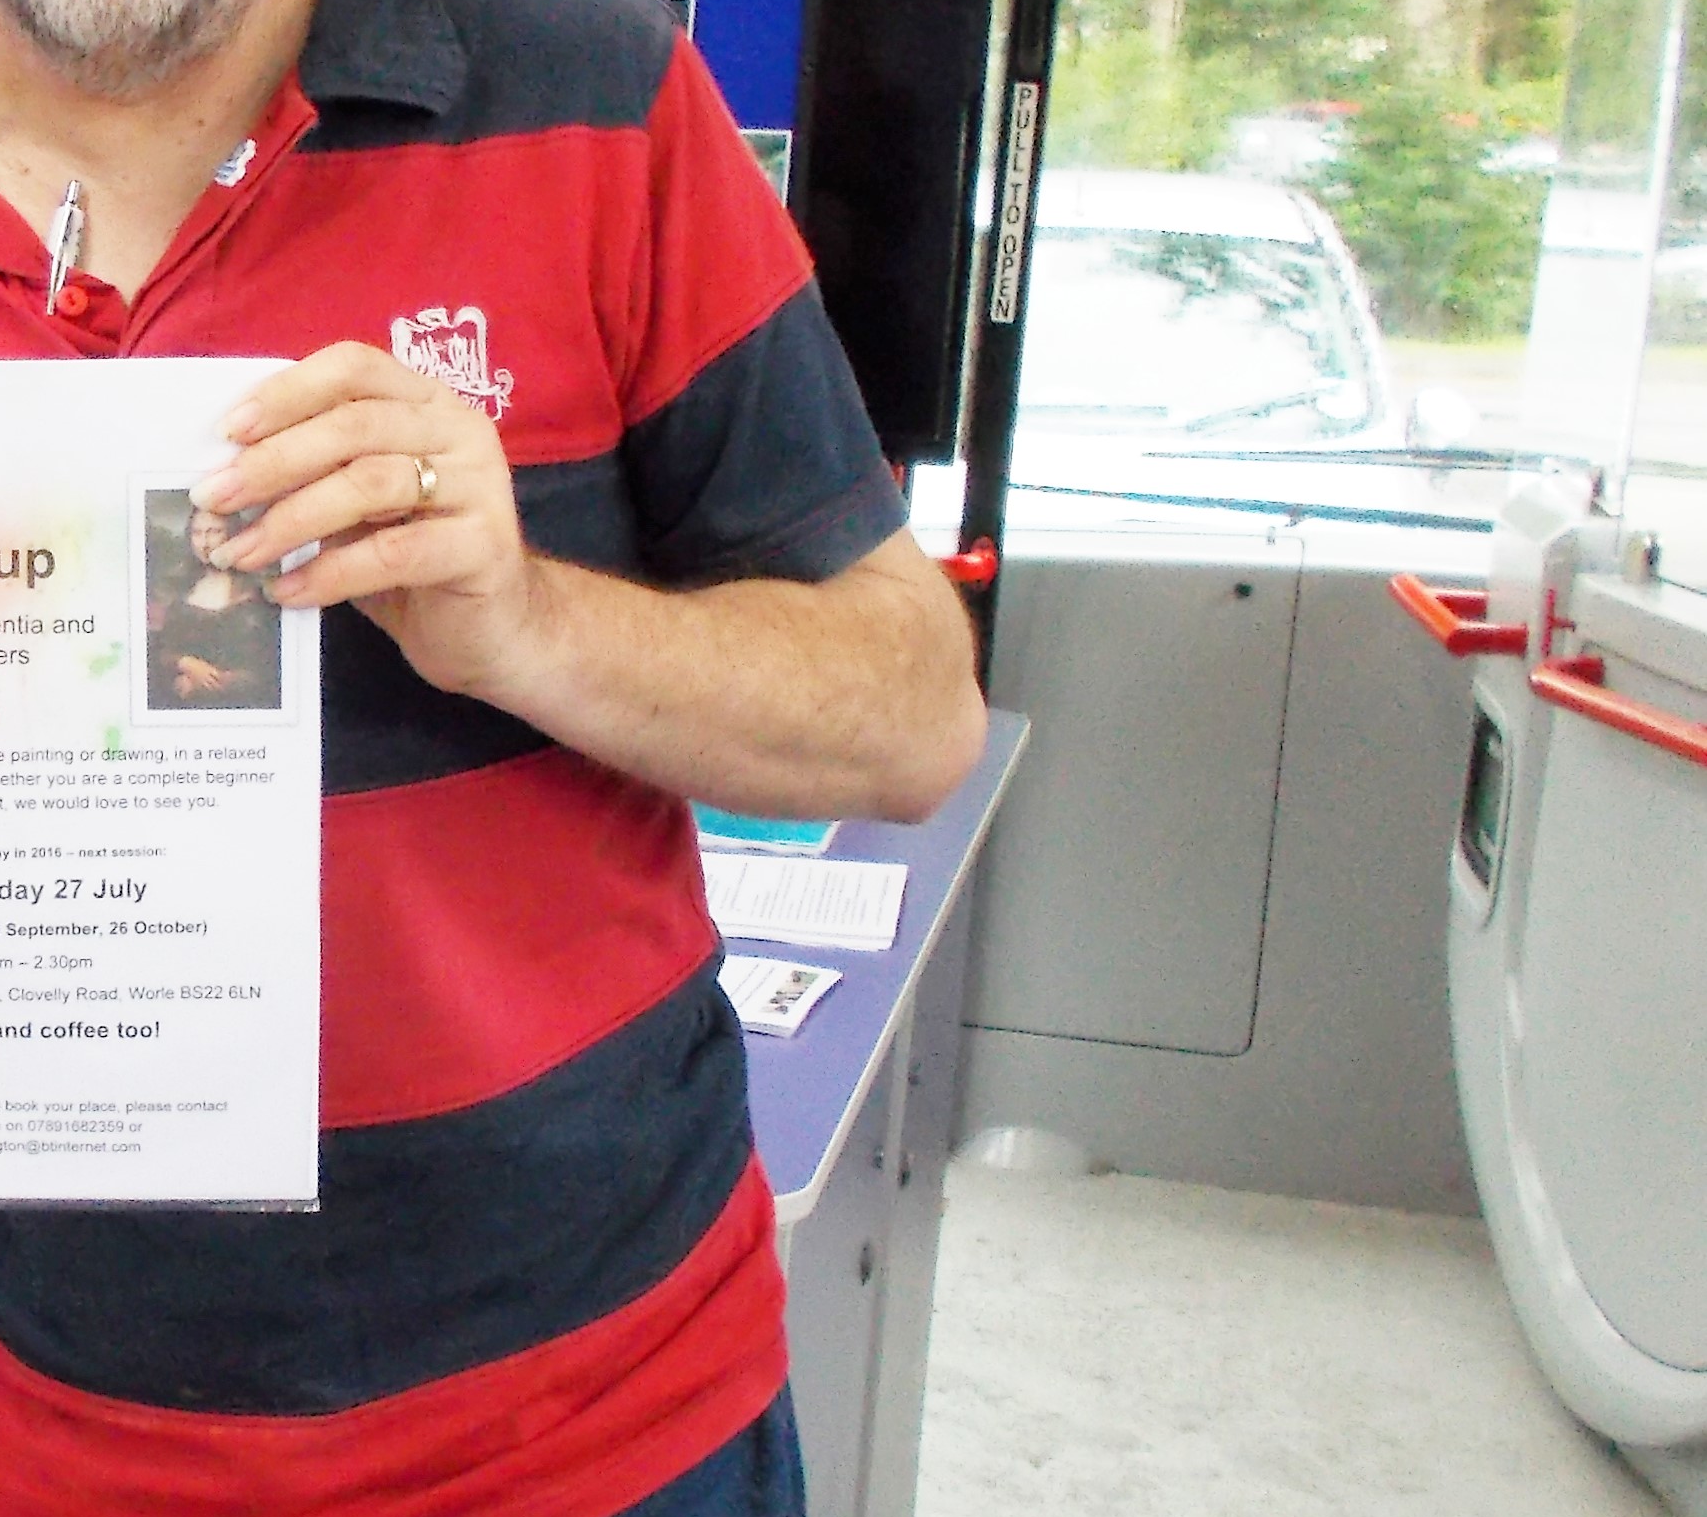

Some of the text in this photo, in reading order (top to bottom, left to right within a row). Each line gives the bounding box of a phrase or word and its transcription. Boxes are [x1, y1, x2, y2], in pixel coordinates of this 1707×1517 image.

[995, 86, 1033, 320] PULL TO OPEN
[51, 614, 95, 635] and
[10, 748, 75, 766] painting
[79, 749, 96, 762] or
[100, 747, 169, 765] drawing,
[174, 749, 188, 761] in
[193, 748, 203, 761] a
[207, 745, 267, 761] relaxed
[46, 774, 77, 789] you
[81, 773, 108, 786] are
[112, 773, 123, 786] a
[127, 770, 201, 788] complete
[205, 769, 276, 788] beginner
[13, 798, 38, 811] we
[41, 795, 90, 810] would
[94, 796, 129, 810] love
[133, 795, 149, 809] to
[153, 796, 183, 809] see
[13, 847, 27, 859] in
[30, 846, 63, 859] 2016
[78, 847, 108, 858] next
[111, 847, 168, 858] session:
[54, 878, 83, 900] 27
[92, 877, 147, 904] July
[5, 922, 103, 940] September,
[108, 920, 129, 936] 26
[133, 920, 208, 936] October)
[32, 954, 95, 973] 2.30pm
[7, 986, 71, 1005] Clovelly
[127, 986, 176, 1001] Worle
[179, 984, 224, 1001] BS22
[227, 984, 262, 1000] 6LN
[39, 1020, 110, 1040] coffee
[116, 1020, 160, 1039] too!
[4, 1099, 39, 1113] book
[43, 1102, 74, 1115] your
[124, 1100, 173, 1116] please
[176, 1100, 229, 1113] contact
[4, 1121, 24, 1132] on
[128, 1122, 143, 1134] or
